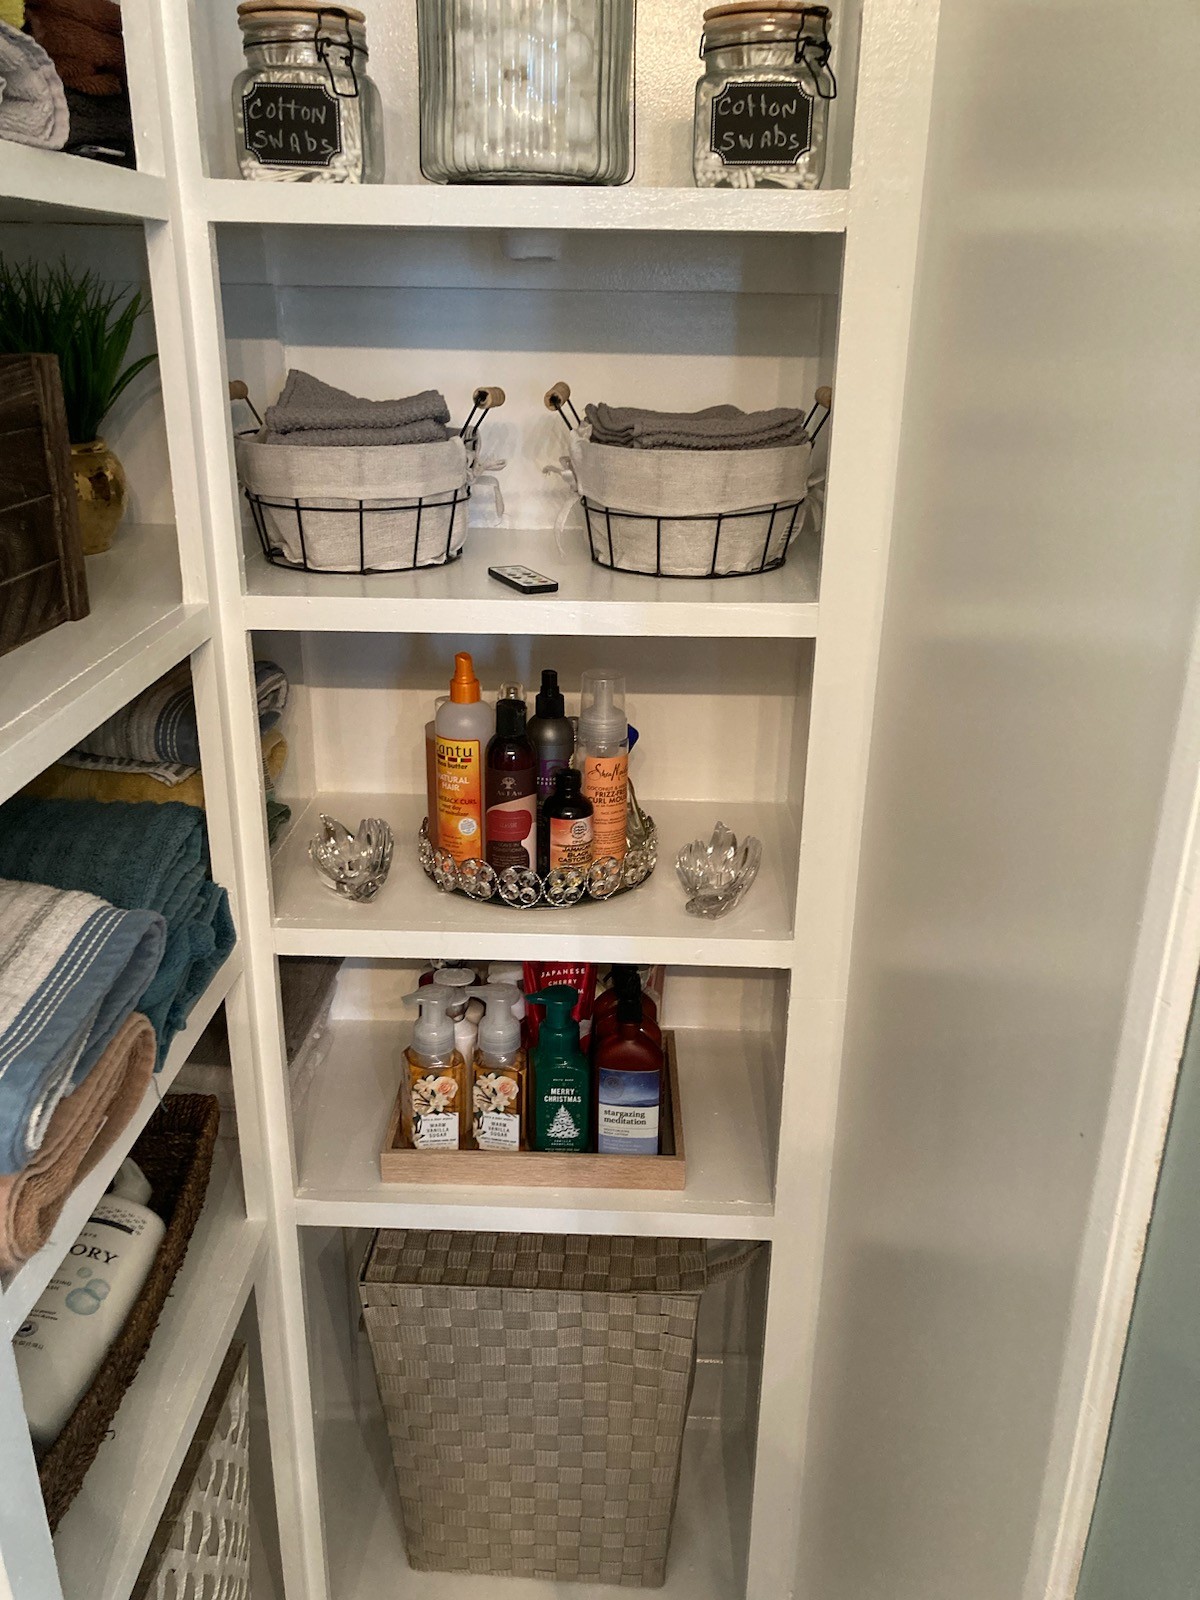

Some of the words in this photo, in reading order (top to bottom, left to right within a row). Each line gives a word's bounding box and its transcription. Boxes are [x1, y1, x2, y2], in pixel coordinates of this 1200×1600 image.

[447, 762, 468, 770] butter
[442, 781, 460, 792] HAIR
[541, 967, 586, 978] JAPANESE
[547, 979, 577, 987] CHERRY
[544, 1095, 582, 1103] CHRISTMAS
[603, 1109, 646, 1119] stargazing
[603, 1116, 647, 1125] meditation
[70, 1243, 119, 1264] ORY
